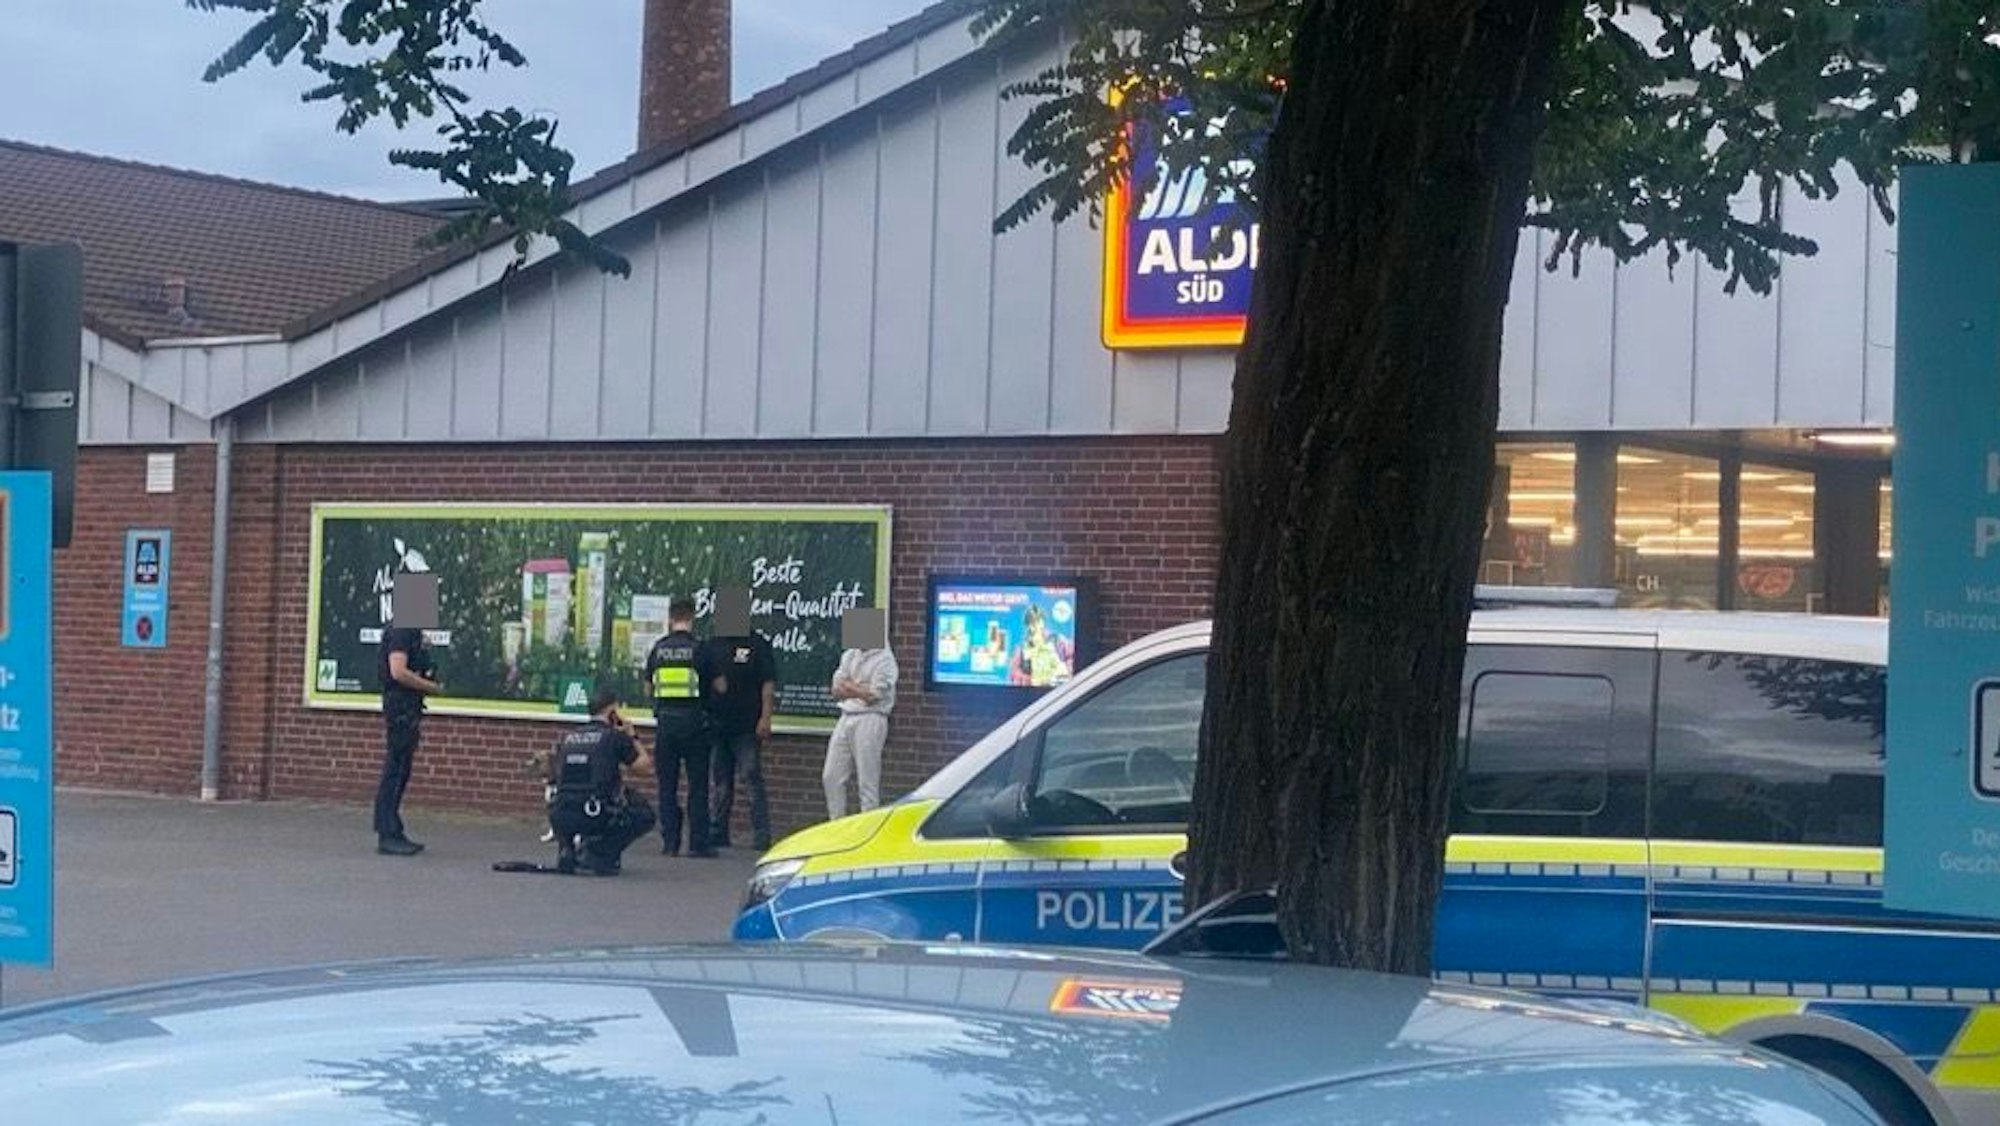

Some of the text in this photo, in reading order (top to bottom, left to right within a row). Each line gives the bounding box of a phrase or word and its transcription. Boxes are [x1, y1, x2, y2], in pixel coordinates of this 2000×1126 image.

[1137, 224, 1260, 274] ALDI
[1177, 275, 1224, 303] SÜD
[752, 554, 804, 588] Beste
[656, 647, 693, 660] POLIZEI
[772, 626, 812, 653] alle.
